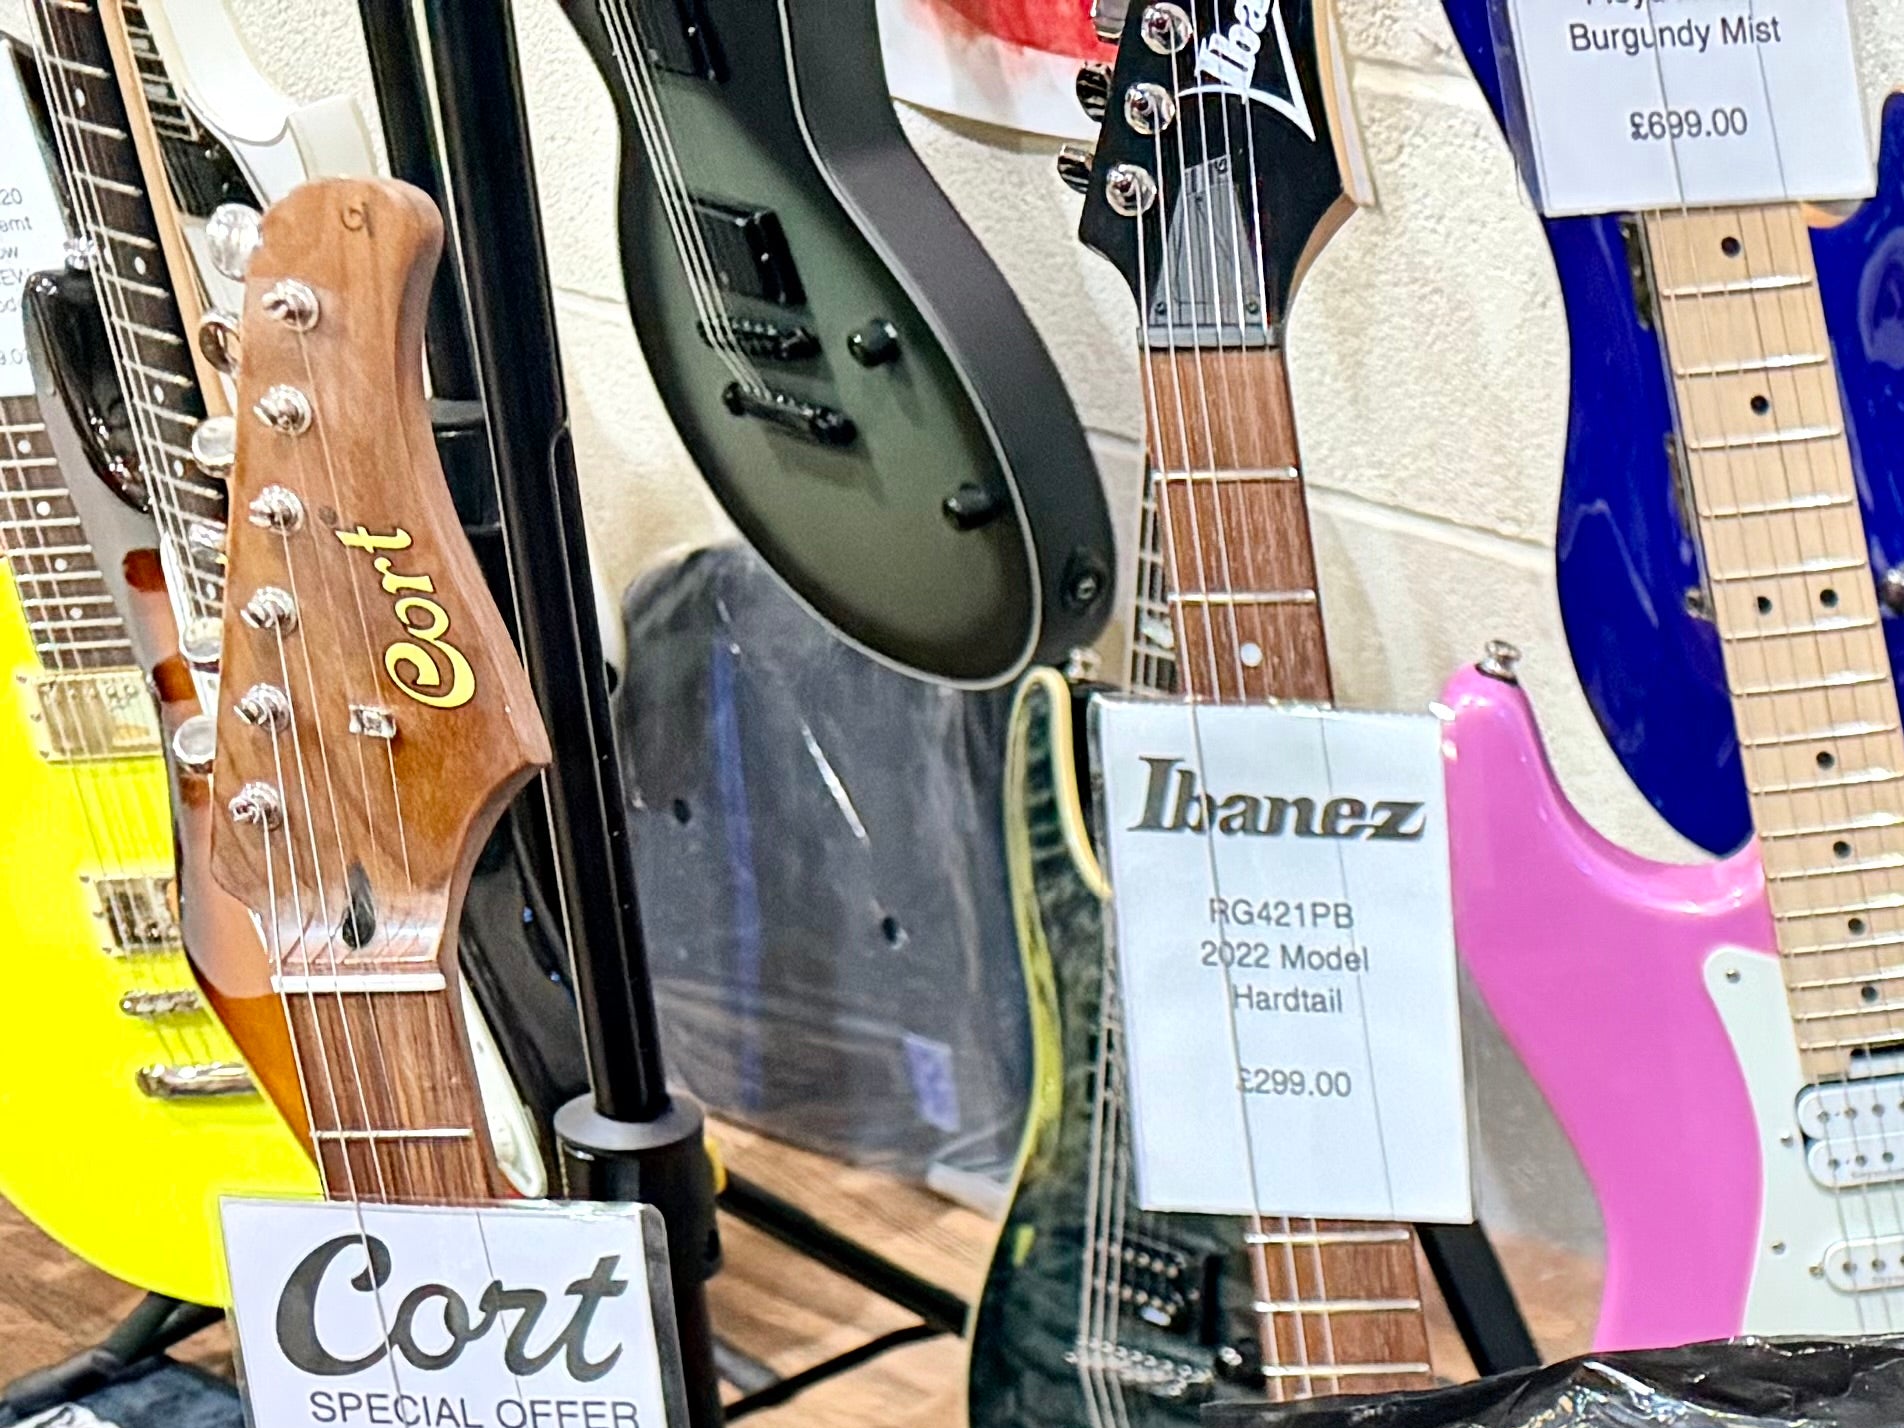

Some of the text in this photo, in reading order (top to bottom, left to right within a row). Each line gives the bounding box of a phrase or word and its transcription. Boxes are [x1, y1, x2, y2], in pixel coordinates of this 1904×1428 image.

[1569, 15, 1782, 56] Burgundy Mist
[1629, 106, 1748, 141] £699.00
[333, 525, 477, 709] Cort
[1126, 756, 1429, 843] Ibanez
[1208, 899, 1355, 930] RG421PB
[1200, 940, 1370, 973] 2022 Model
[1233, 984, 1343, 1013] Hardtail
[1237, 1068, 1352, 1097] £299.00
[274, 1232, 629, 1384] Cort
